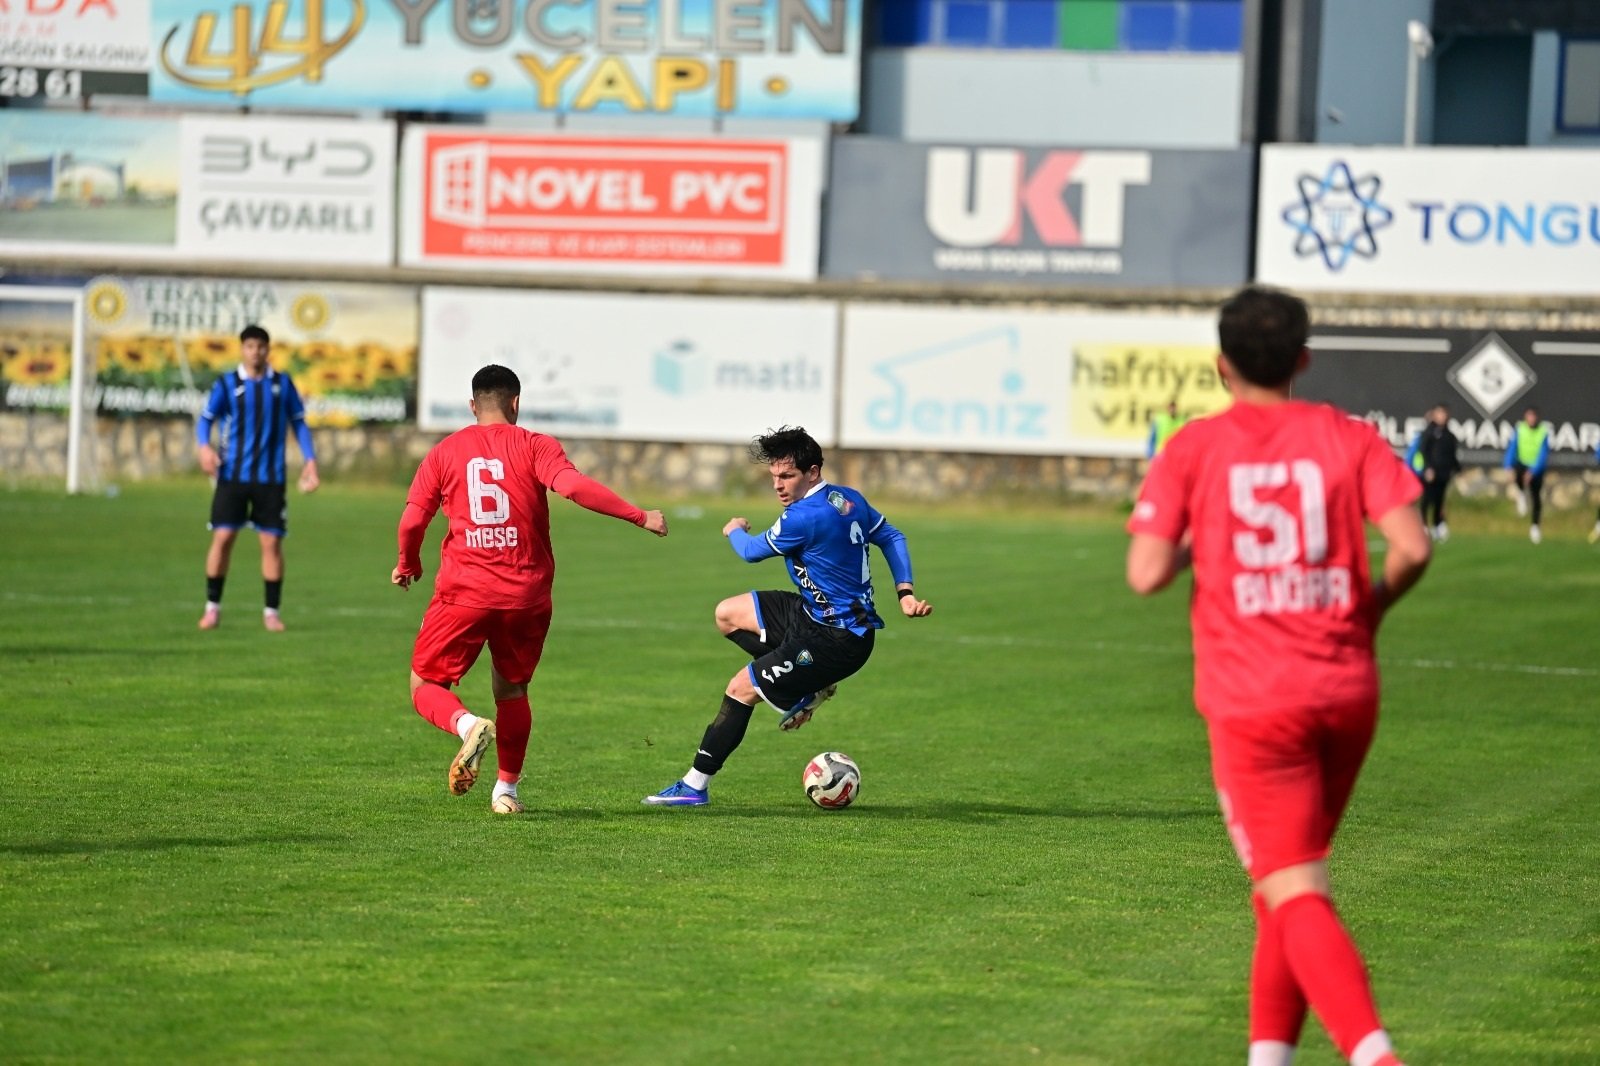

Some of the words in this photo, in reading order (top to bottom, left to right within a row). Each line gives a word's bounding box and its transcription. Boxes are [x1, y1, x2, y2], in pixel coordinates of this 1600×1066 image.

[45, 69, 82, 99] 61
[516, 53, 738, 111] YAPI
[201, 134, 375, 177] BYD
[490, 168, 657, 212] NOVEL
[671, 172, 767, 214] PVC
[926, 147, 1152, 248] UKT
[200, 203, 374, 237] ÇAVDARLI
[1411, 200, 1600, 245] TONG
[1481, 361, 1505, 394] S
[467, 457, 510, 525] 6
[1229, 459, 1328, 569] 51
